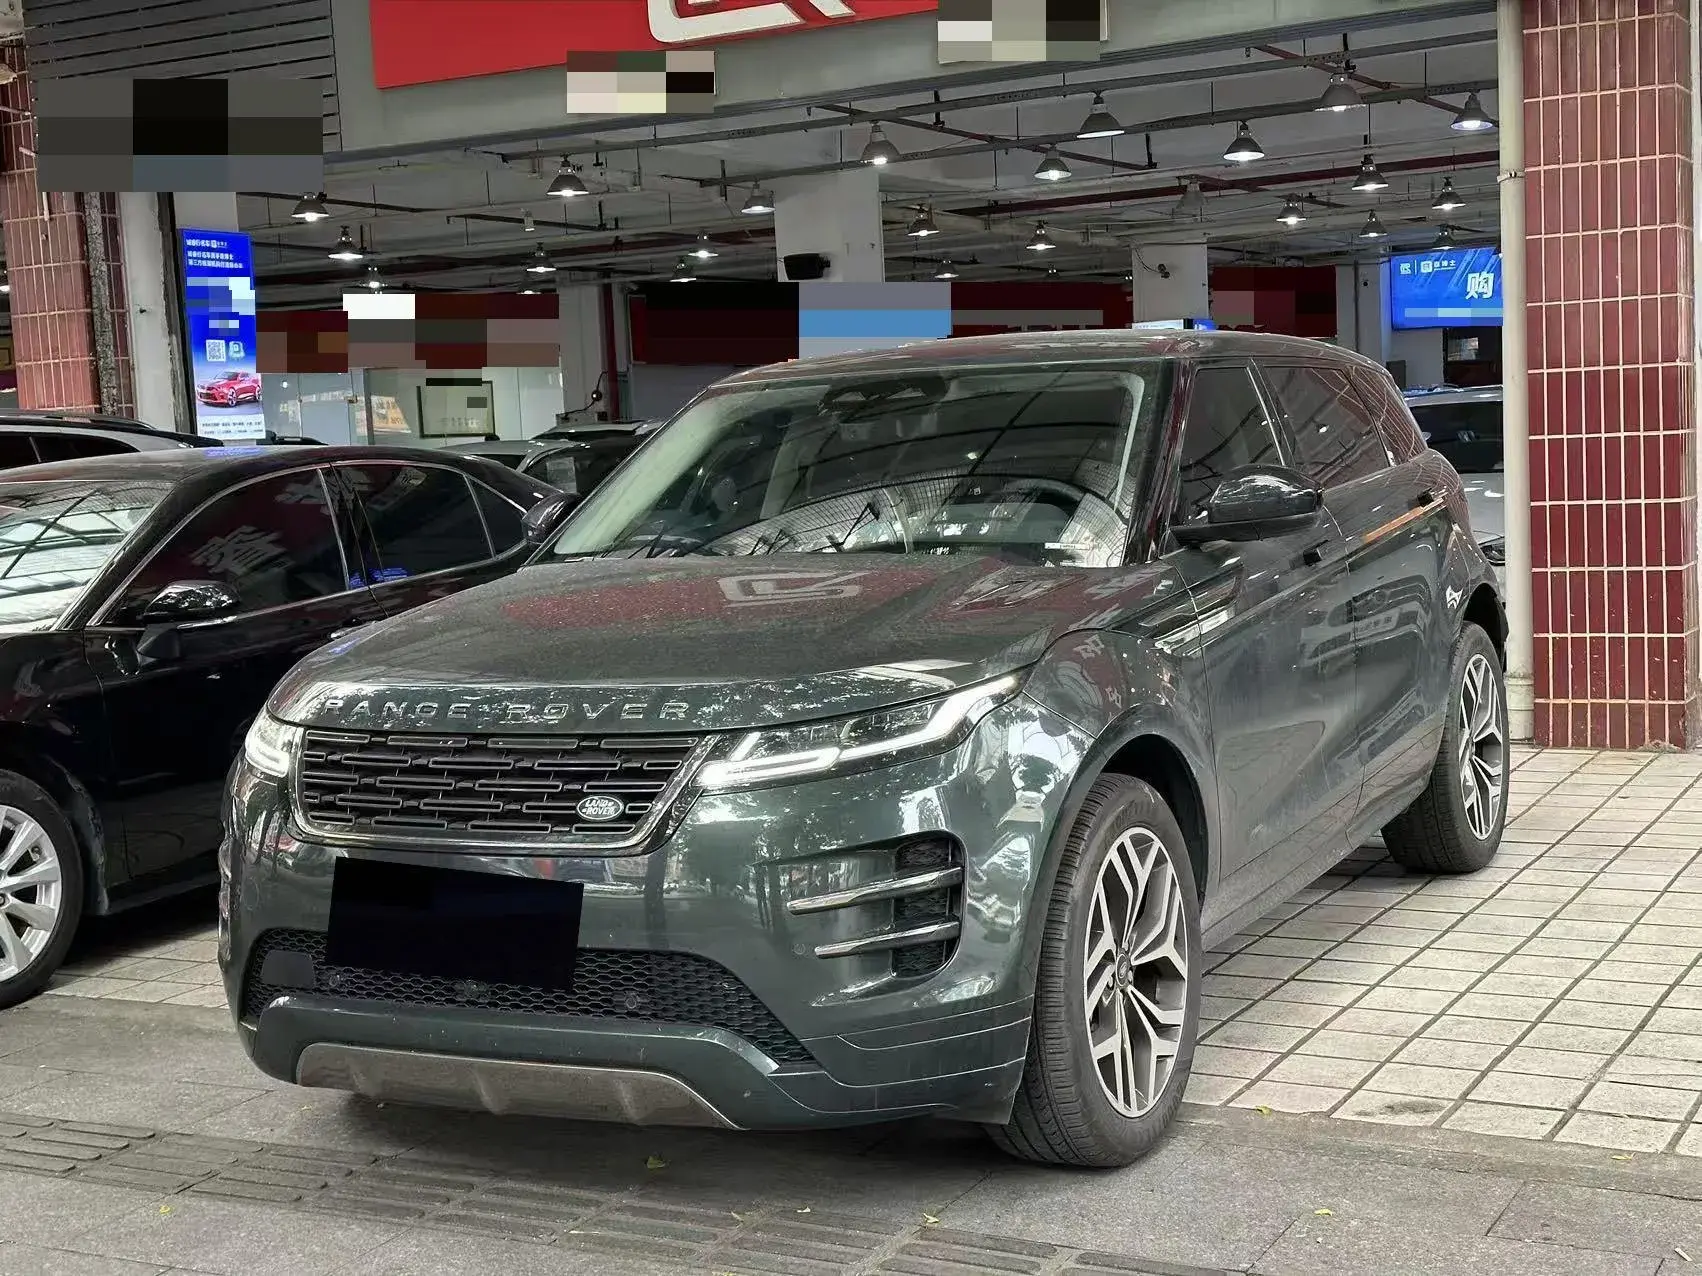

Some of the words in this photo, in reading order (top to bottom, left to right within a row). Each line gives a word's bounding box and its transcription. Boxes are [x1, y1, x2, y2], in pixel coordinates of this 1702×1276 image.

[1465, 271, 1495, 300] 购
[324, 700, 472, 719] RANGE
[505, 701, 691, 720] ROVER
[585, 799, 609, 807] LAND
[585, 806, 616, 815] ROVER
